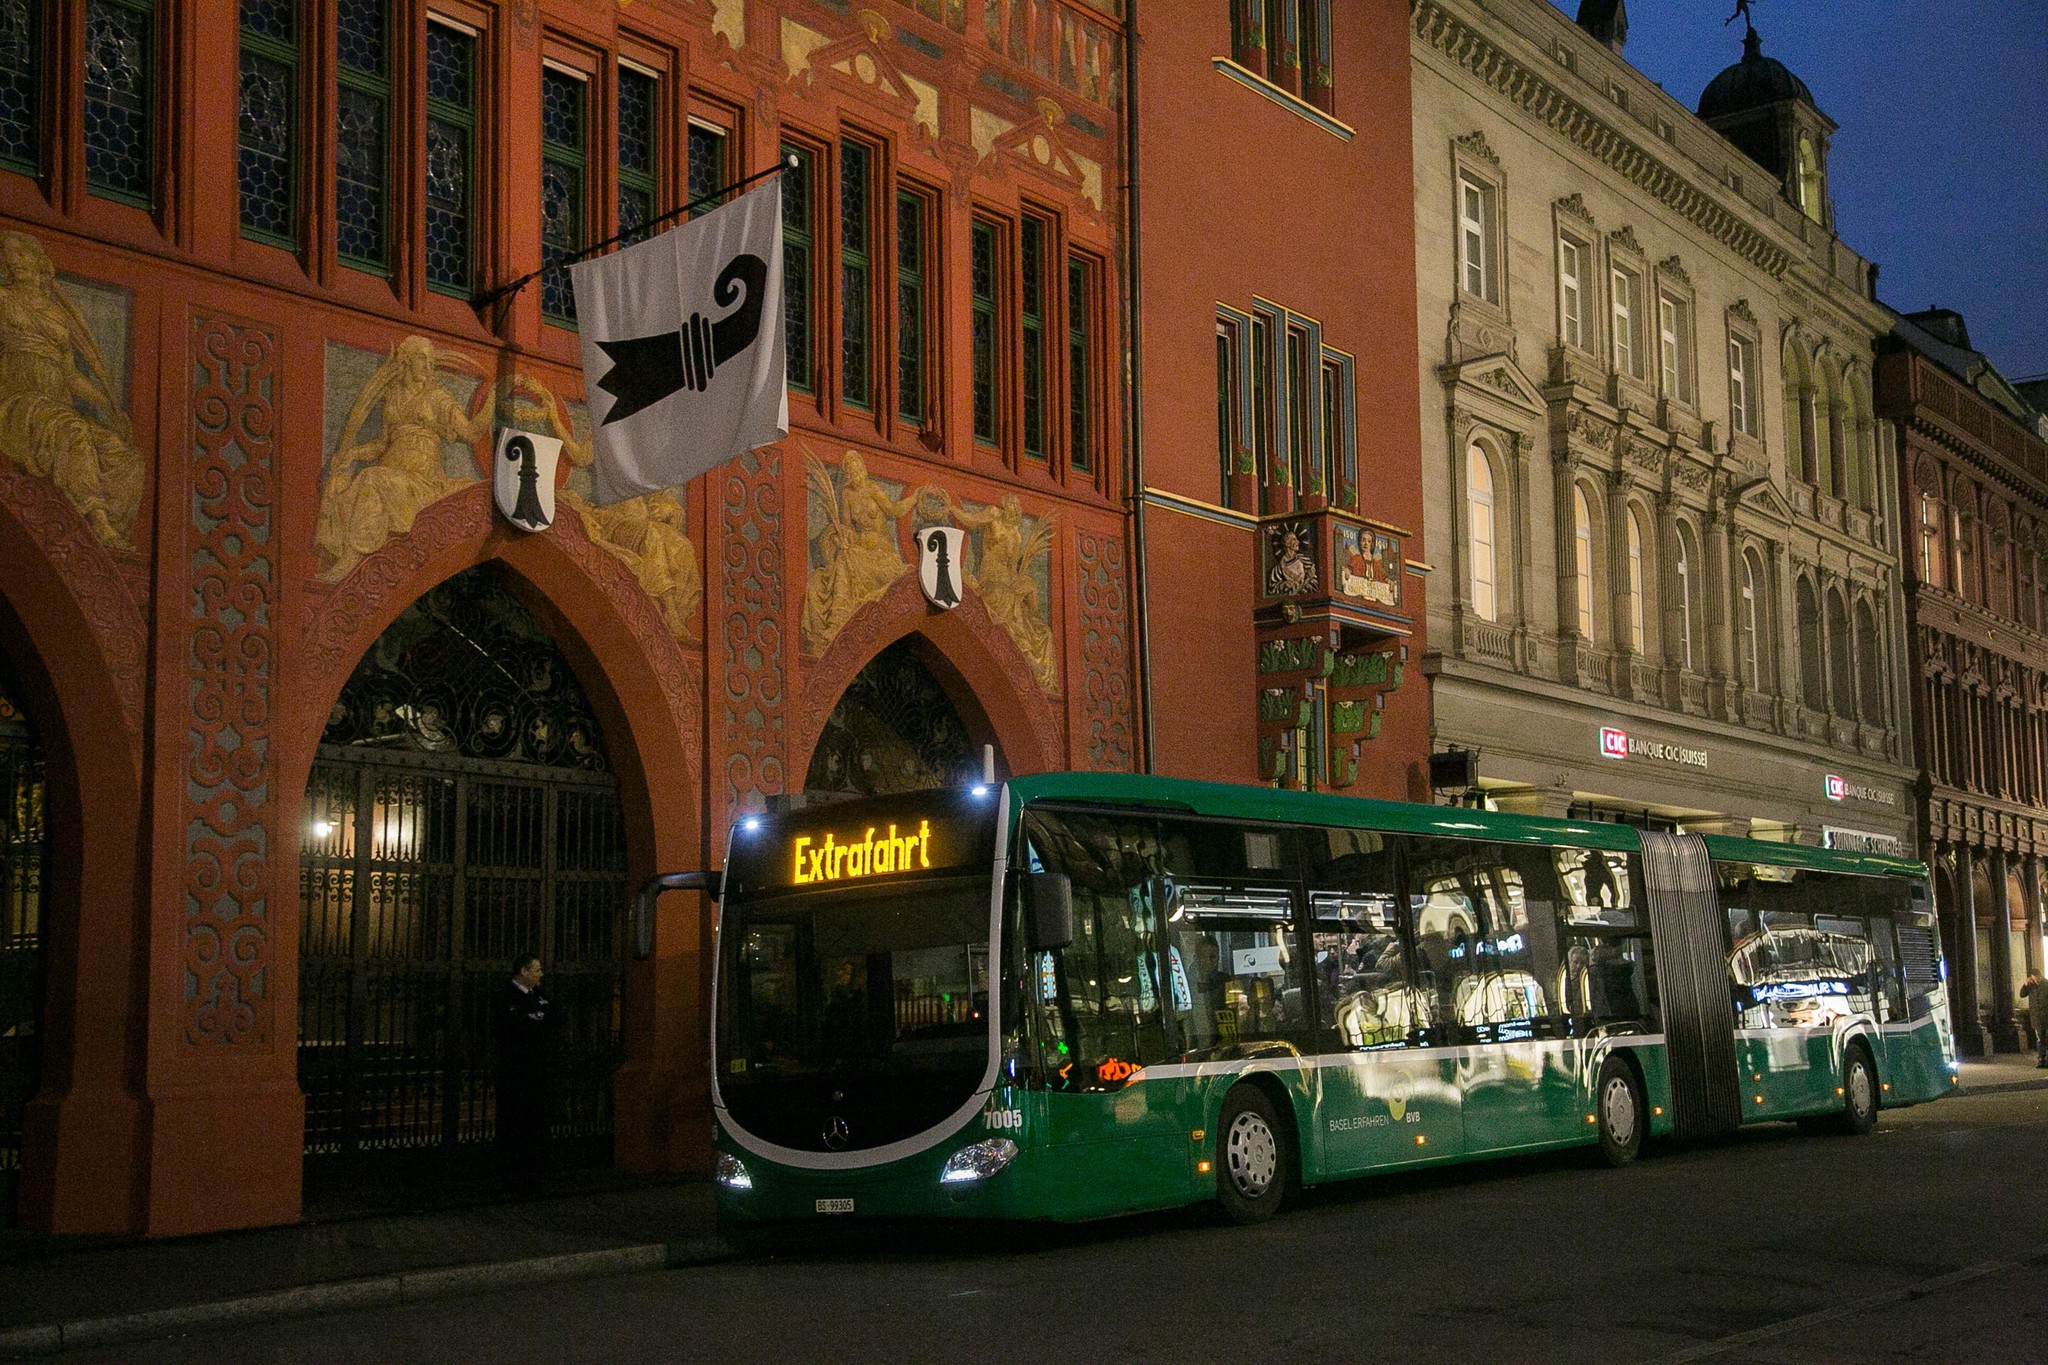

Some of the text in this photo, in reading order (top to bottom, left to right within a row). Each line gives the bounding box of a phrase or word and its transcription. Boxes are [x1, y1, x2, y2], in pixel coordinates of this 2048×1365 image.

[1606, 733, 1626, 752] CIC
[1628, 738, 1664, 760] BANQUE
[1665, 745, 1680, 762] CIC
[1830, 779, 1844, 796] CIC
[794, 819, 931, 884] Extrafahrt
[983, 1108, 1023, 1130] 7005
[1406, 1111, 1421, 1124] BVB
